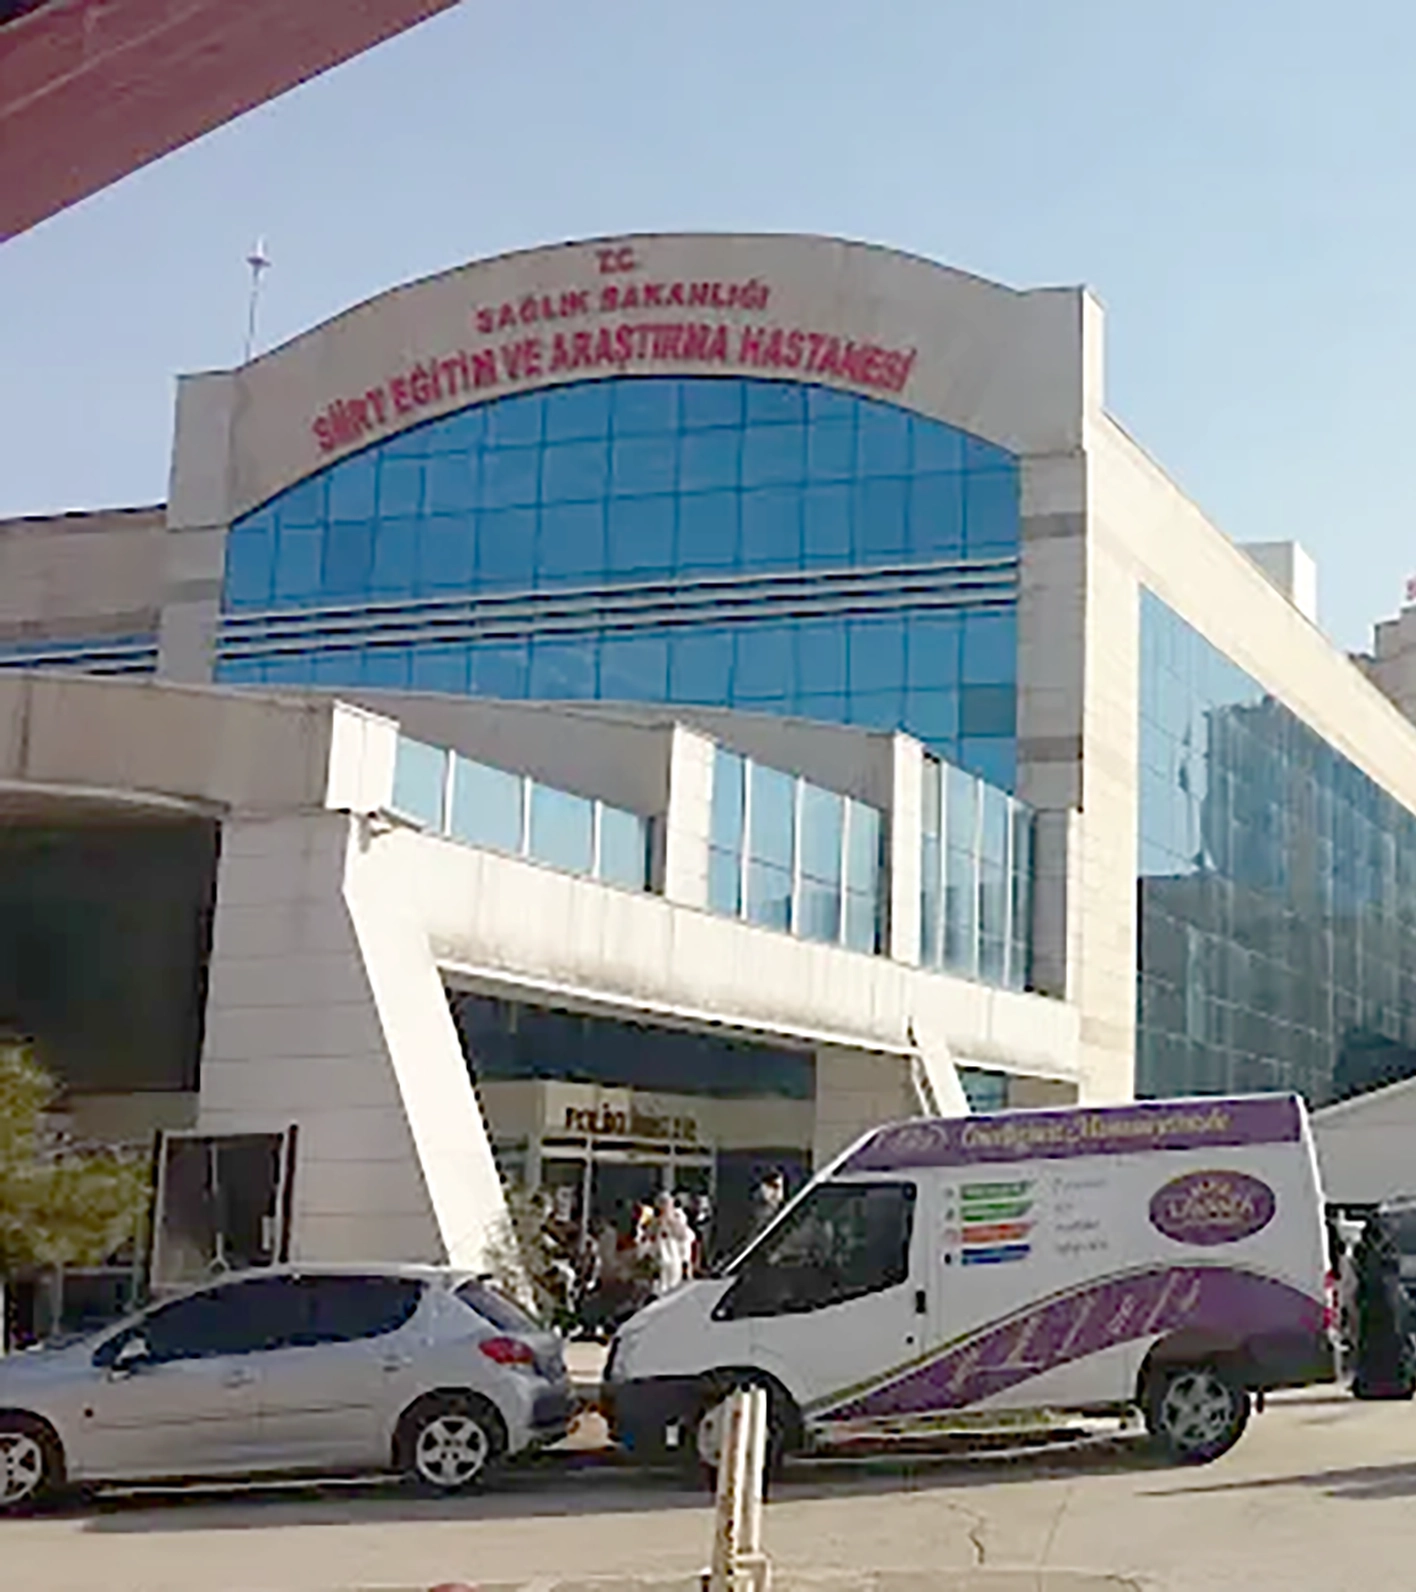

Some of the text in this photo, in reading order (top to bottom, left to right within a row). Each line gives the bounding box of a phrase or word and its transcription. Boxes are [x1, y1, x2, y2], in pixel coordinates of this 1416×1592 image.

[600, 277, 770, 312] BAKANLIĞI
[389, 348, 497, 415] EĞİTİM
[501, 337, 543, 379] VE
[550, 322, 727, 372] ARAŞTIRMA
[739, 326, 917, 393] HASTANESİ
